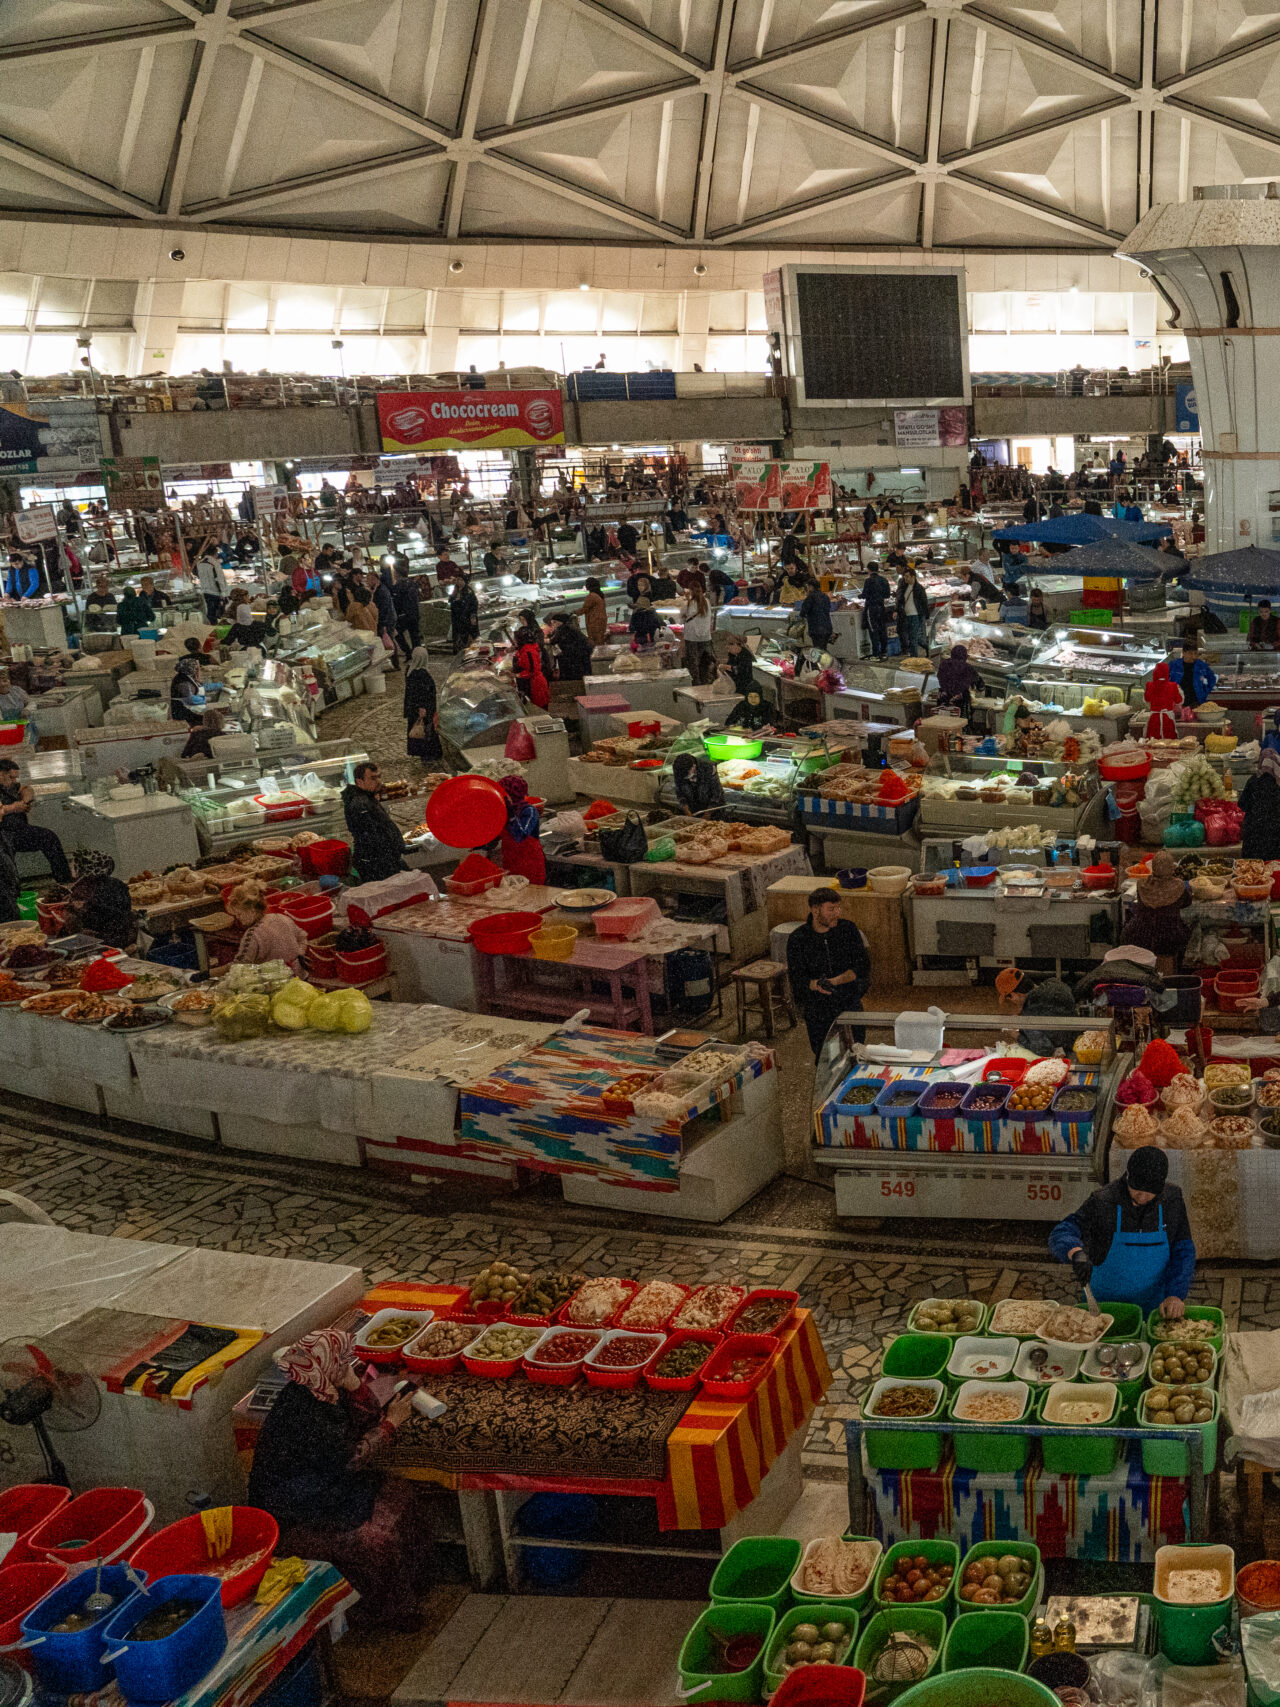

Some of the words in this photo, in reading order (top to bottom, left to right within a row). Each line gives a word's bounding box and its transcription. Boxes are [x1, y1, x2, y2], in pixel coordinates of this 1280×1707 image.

[431, 402, 519, 419] Chococream
[881, 1181, 915, 1197] 549
[1027, 1184, 1062, 1201] 550
